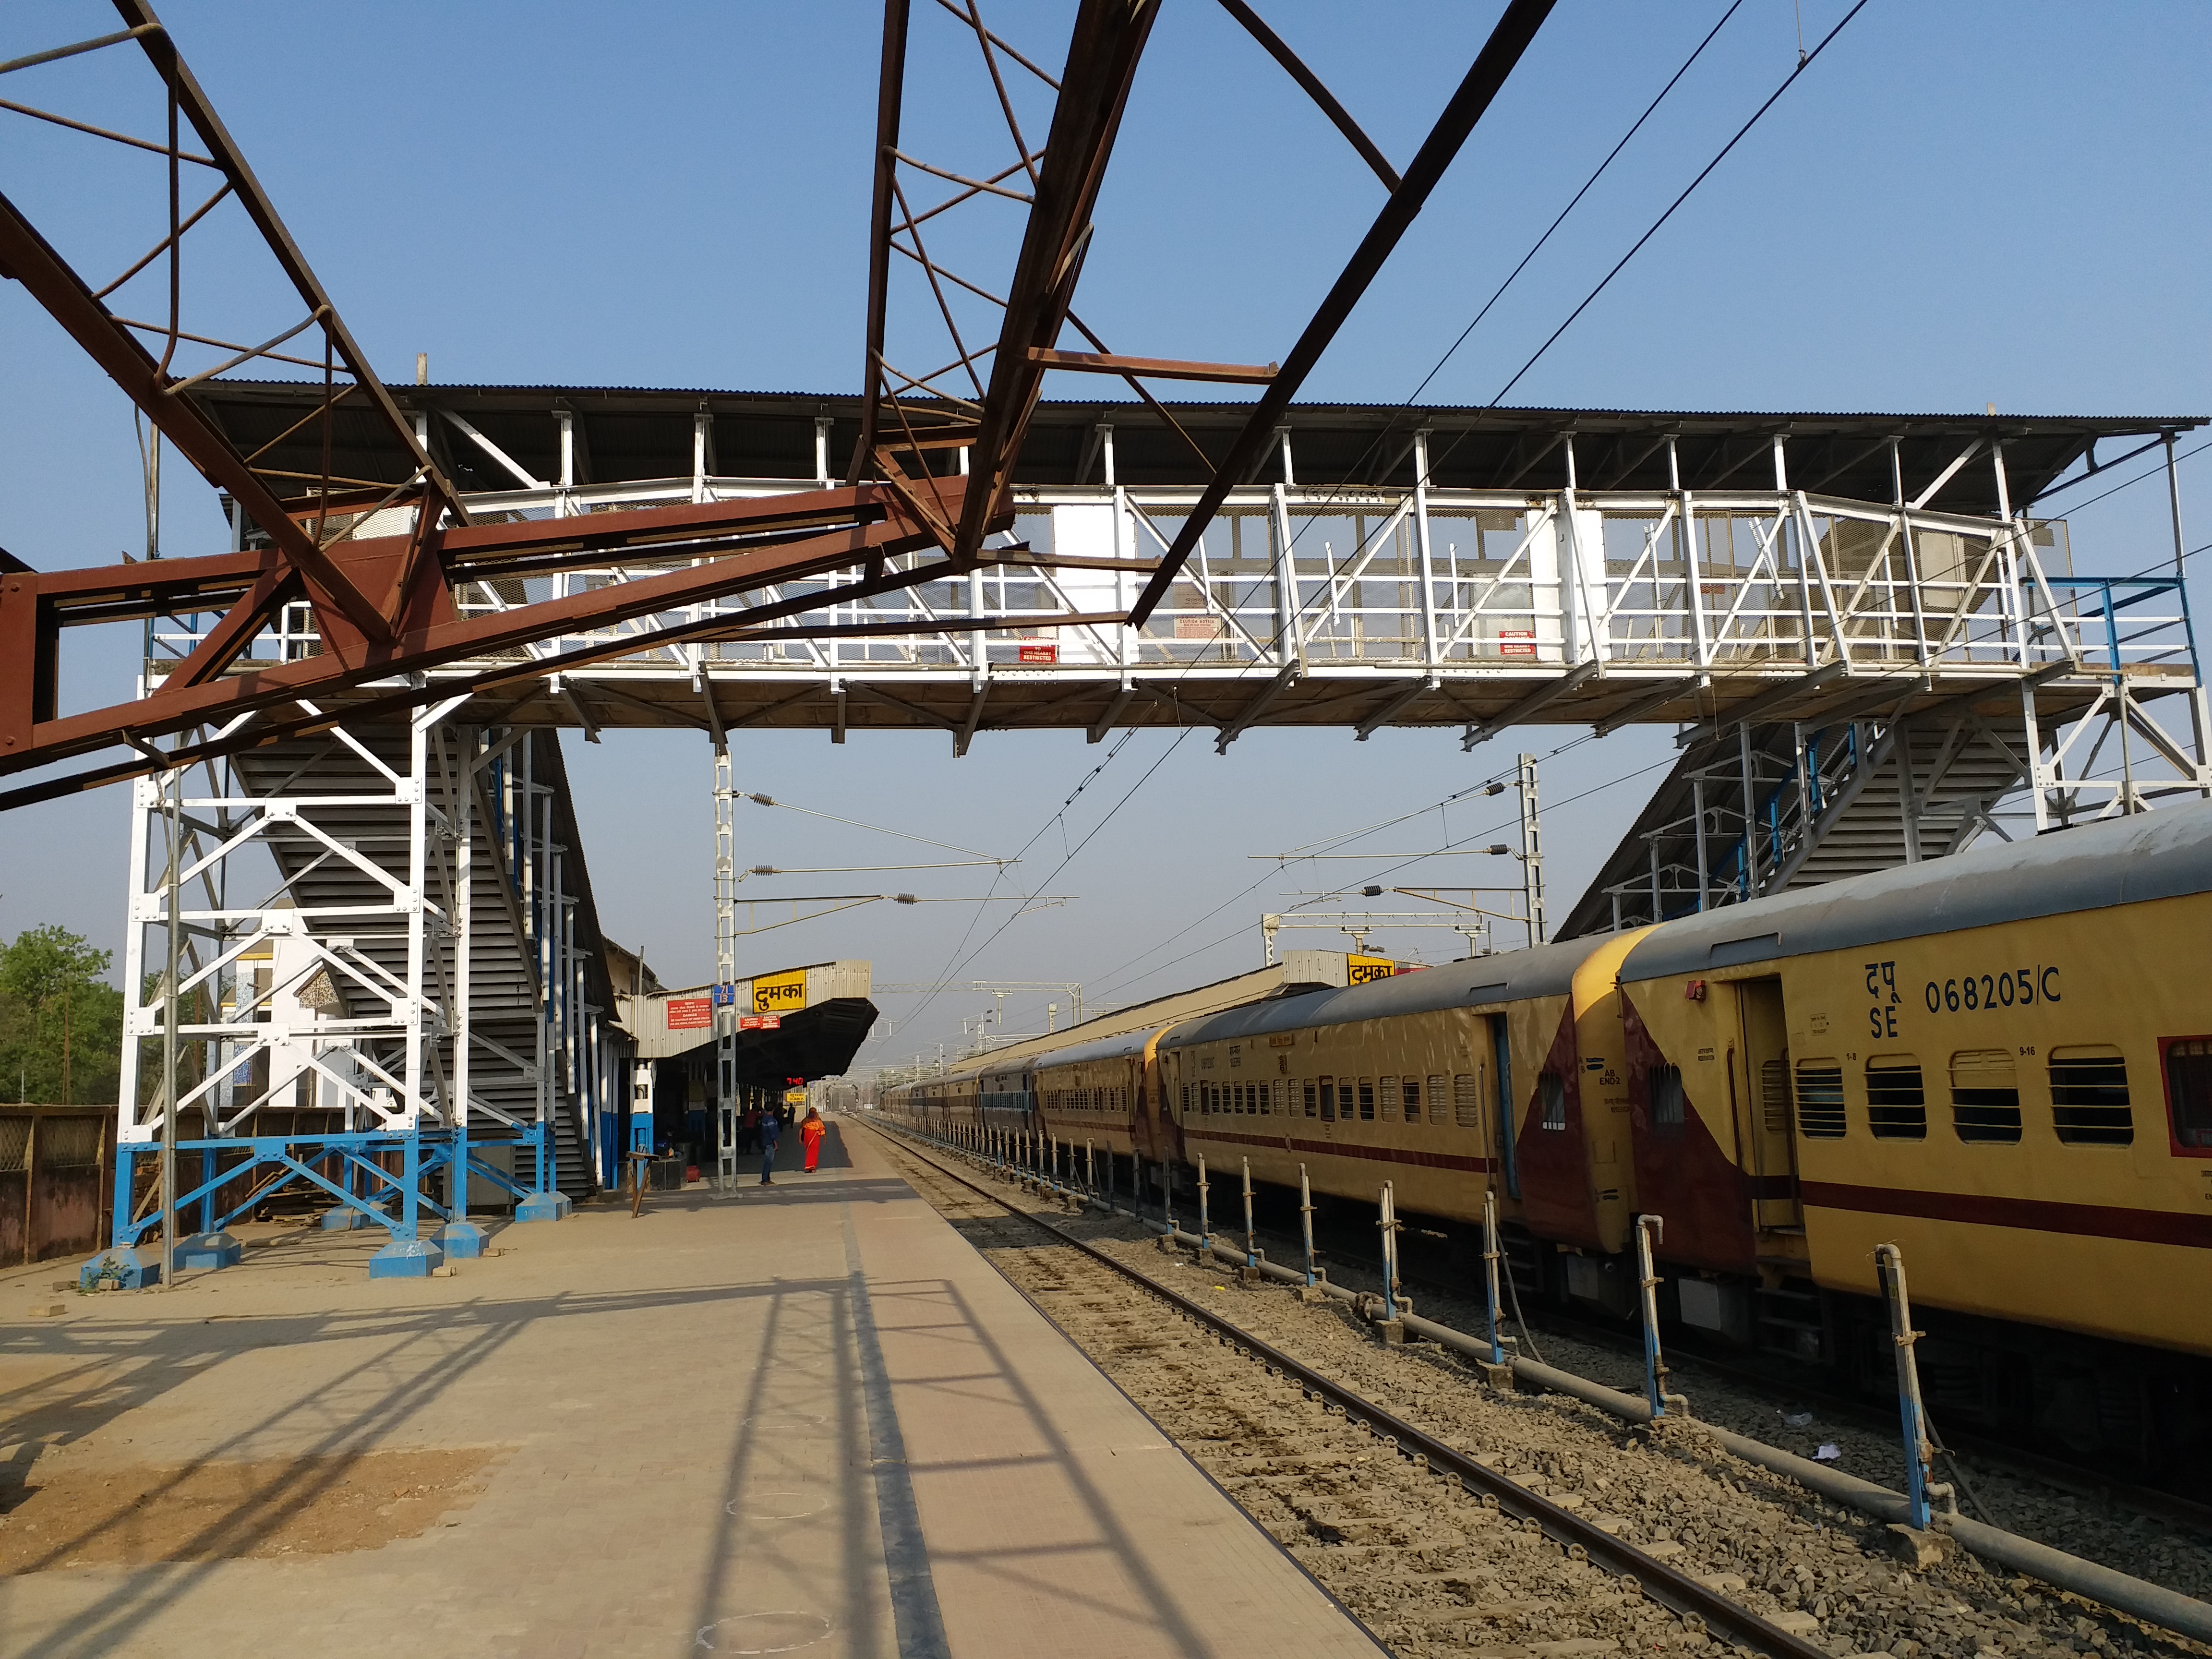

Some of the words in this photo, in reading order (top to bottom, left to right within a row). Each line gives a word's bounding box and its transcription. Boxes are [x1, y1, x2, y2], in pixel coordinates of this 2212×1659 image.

[1865, 961, 1902, 1004] दपू
[1925, 964, 2061, 1013] 068205/C
[720, 994, 728, 1003] 13
[756, 984, 804, 1011] दुमका
[1870, 1006, 1898, 1039] SE
[2020, 1046, 2035, 1056] 9-16
[1599, 1077, 1621, 1085] END-2
